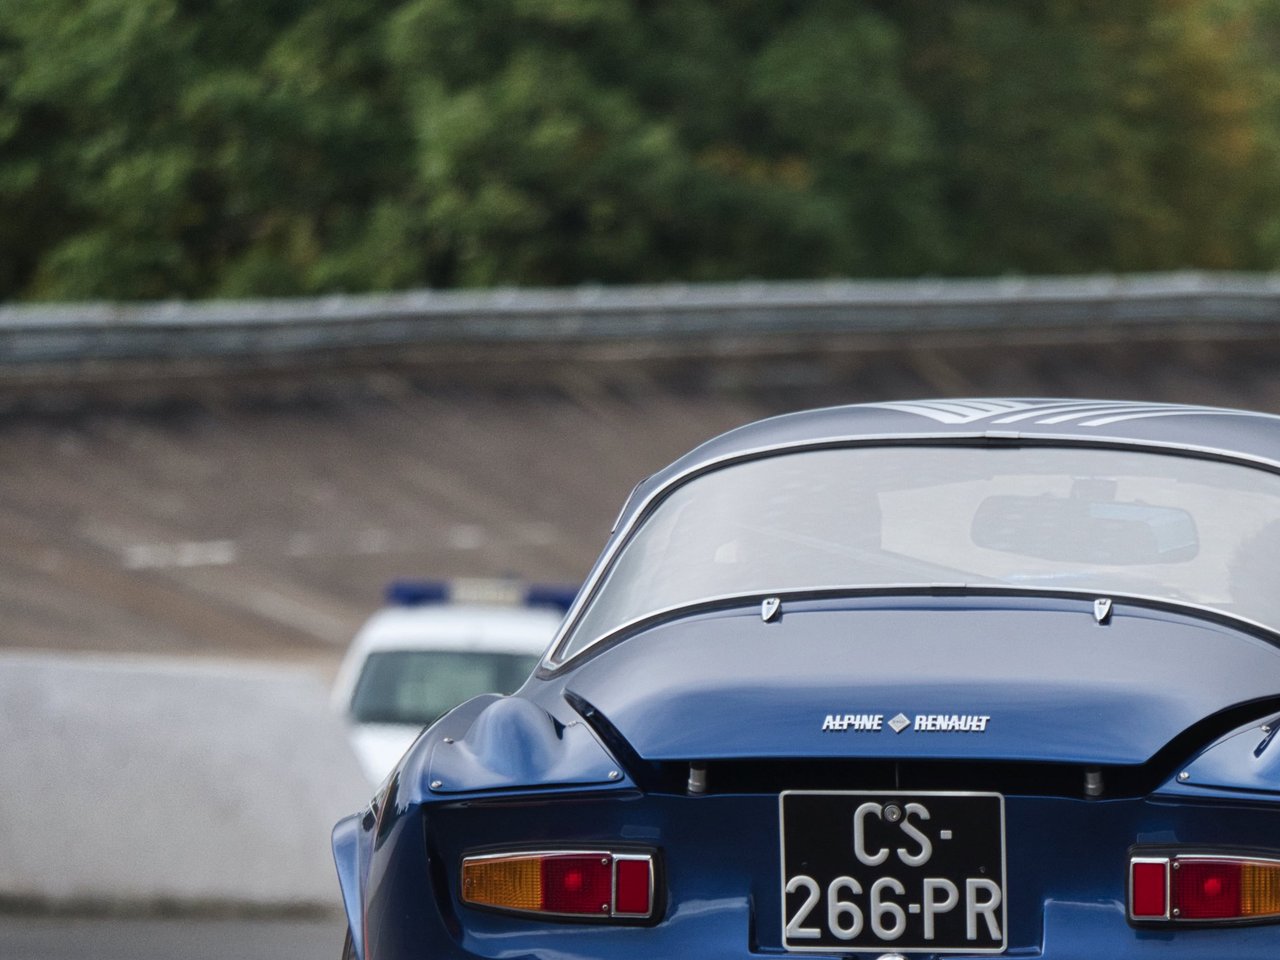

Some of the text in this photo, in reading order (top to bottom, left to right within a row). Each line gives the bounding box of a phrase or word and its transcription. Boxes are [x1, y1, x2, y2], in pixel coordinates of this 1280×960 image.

[822, 714, 990, 732] ALPINE RENAULT
[785, 875, 1002, 940] 266-PR
